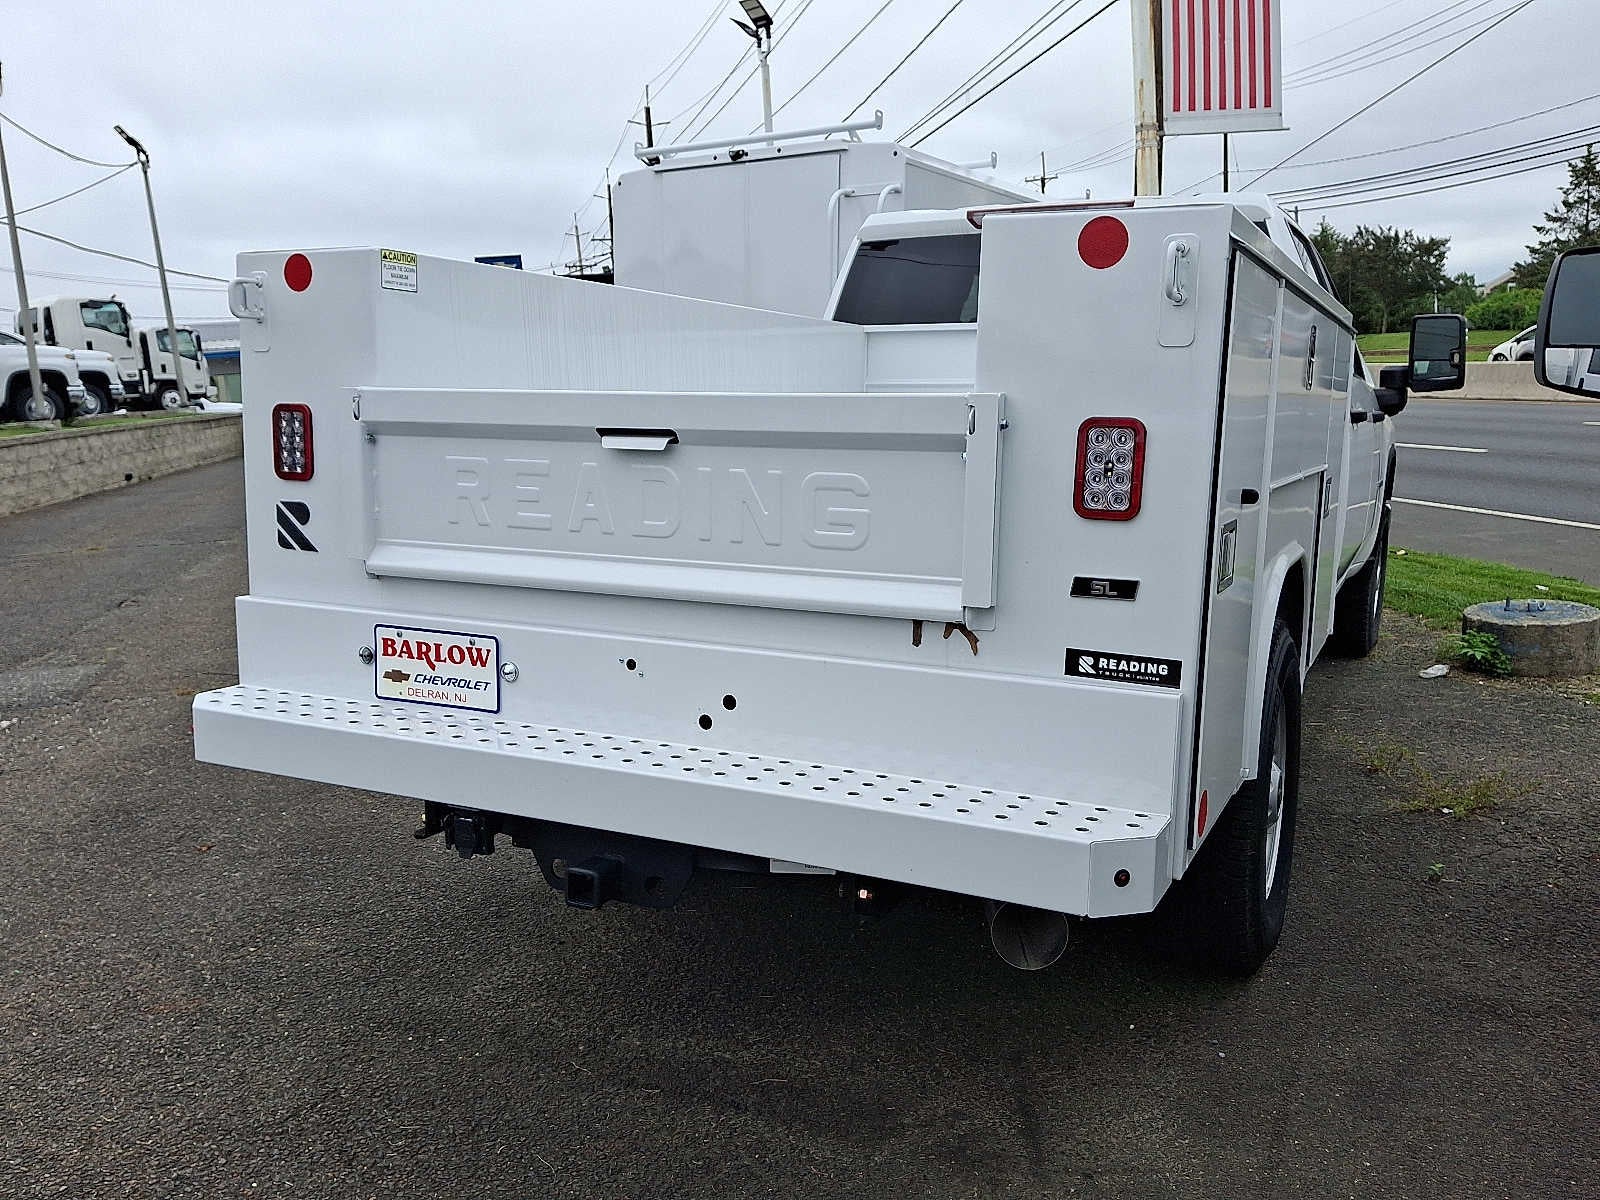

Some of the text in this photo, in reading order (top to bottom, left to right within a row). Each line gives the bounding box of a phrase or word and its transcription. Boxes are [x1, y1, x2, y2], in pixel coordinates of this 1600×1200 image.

[388, 252, 416, 264] CAUTION
[445, 456, 871, 551] READING
[1090, 581, 1118, 596] SL
[381, 637, 491, 671] BARLOW
[1098, 657, 1169, 676] READING
[414, 673, 492, 691] CHEVROLET
[407, 687, 468, 702] DELRAN, NJ
